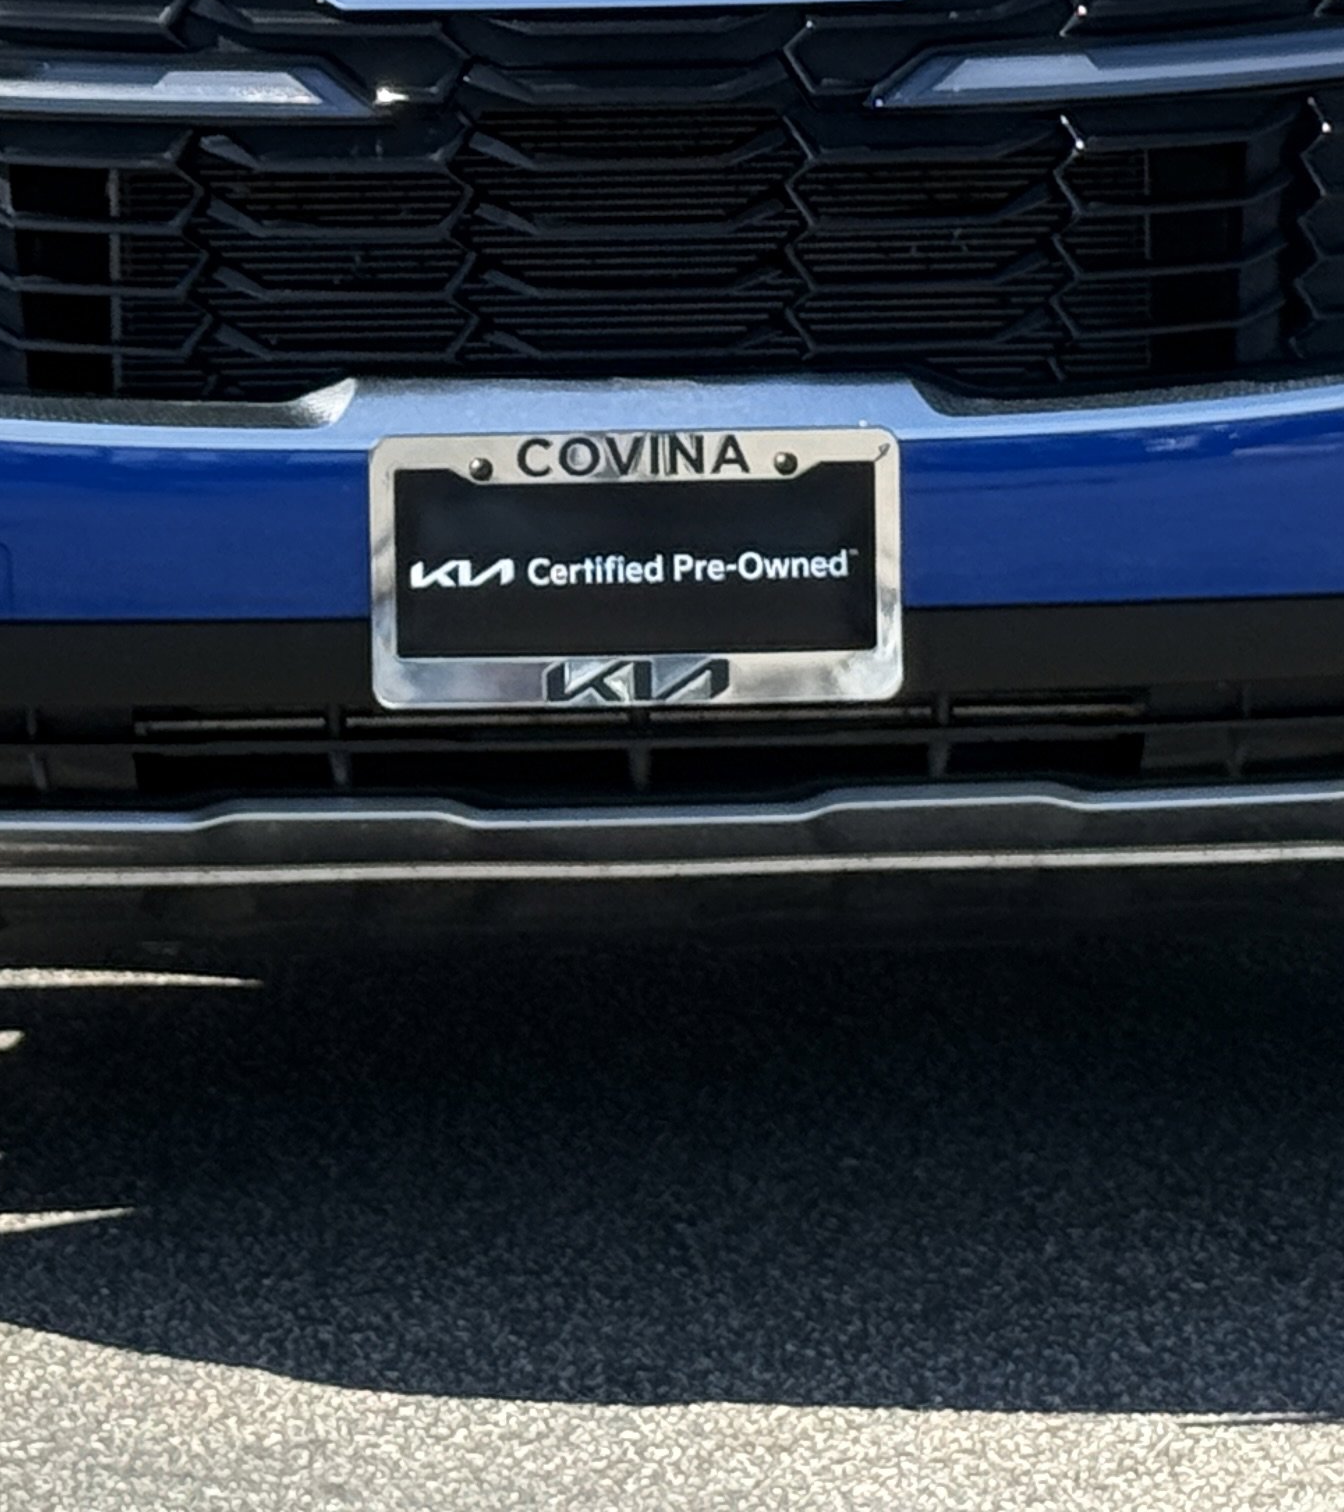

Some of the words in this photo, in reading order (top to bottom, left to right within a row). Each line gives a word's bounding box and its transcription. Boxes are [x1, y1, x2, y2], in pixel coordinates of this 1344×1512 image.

[517, 433, 751, 477] COVINA
[410, 558, 515, 588] KIA
[527, 553, 664, 586] Certified
[673, 550, 849, 581] Pre-Owned
[545, 658, 730, 704] KIA
